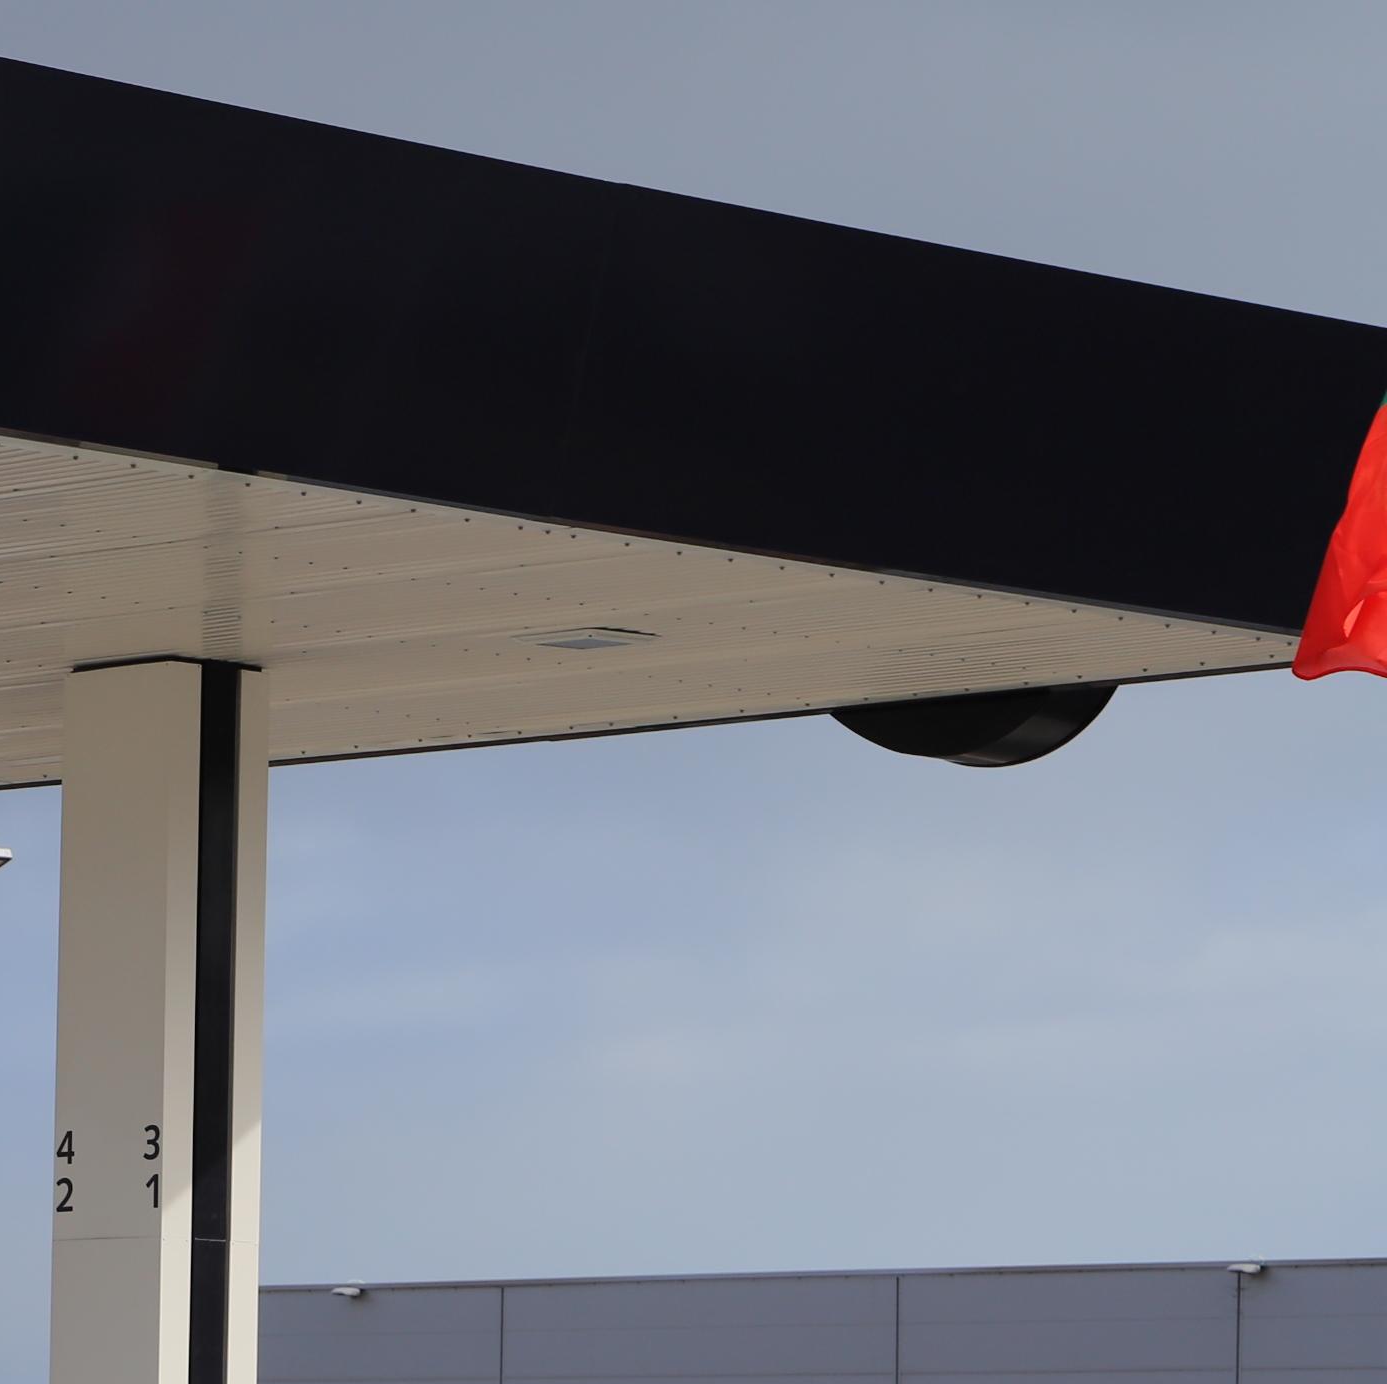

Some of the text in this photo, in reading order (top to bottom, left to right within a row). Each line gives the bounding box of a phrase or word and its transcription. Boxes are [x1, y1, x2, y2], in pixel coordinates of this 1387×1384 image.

[56, 1124, 161, 1165] 4 3
[56, 1173, 160, 1213] 2 1
